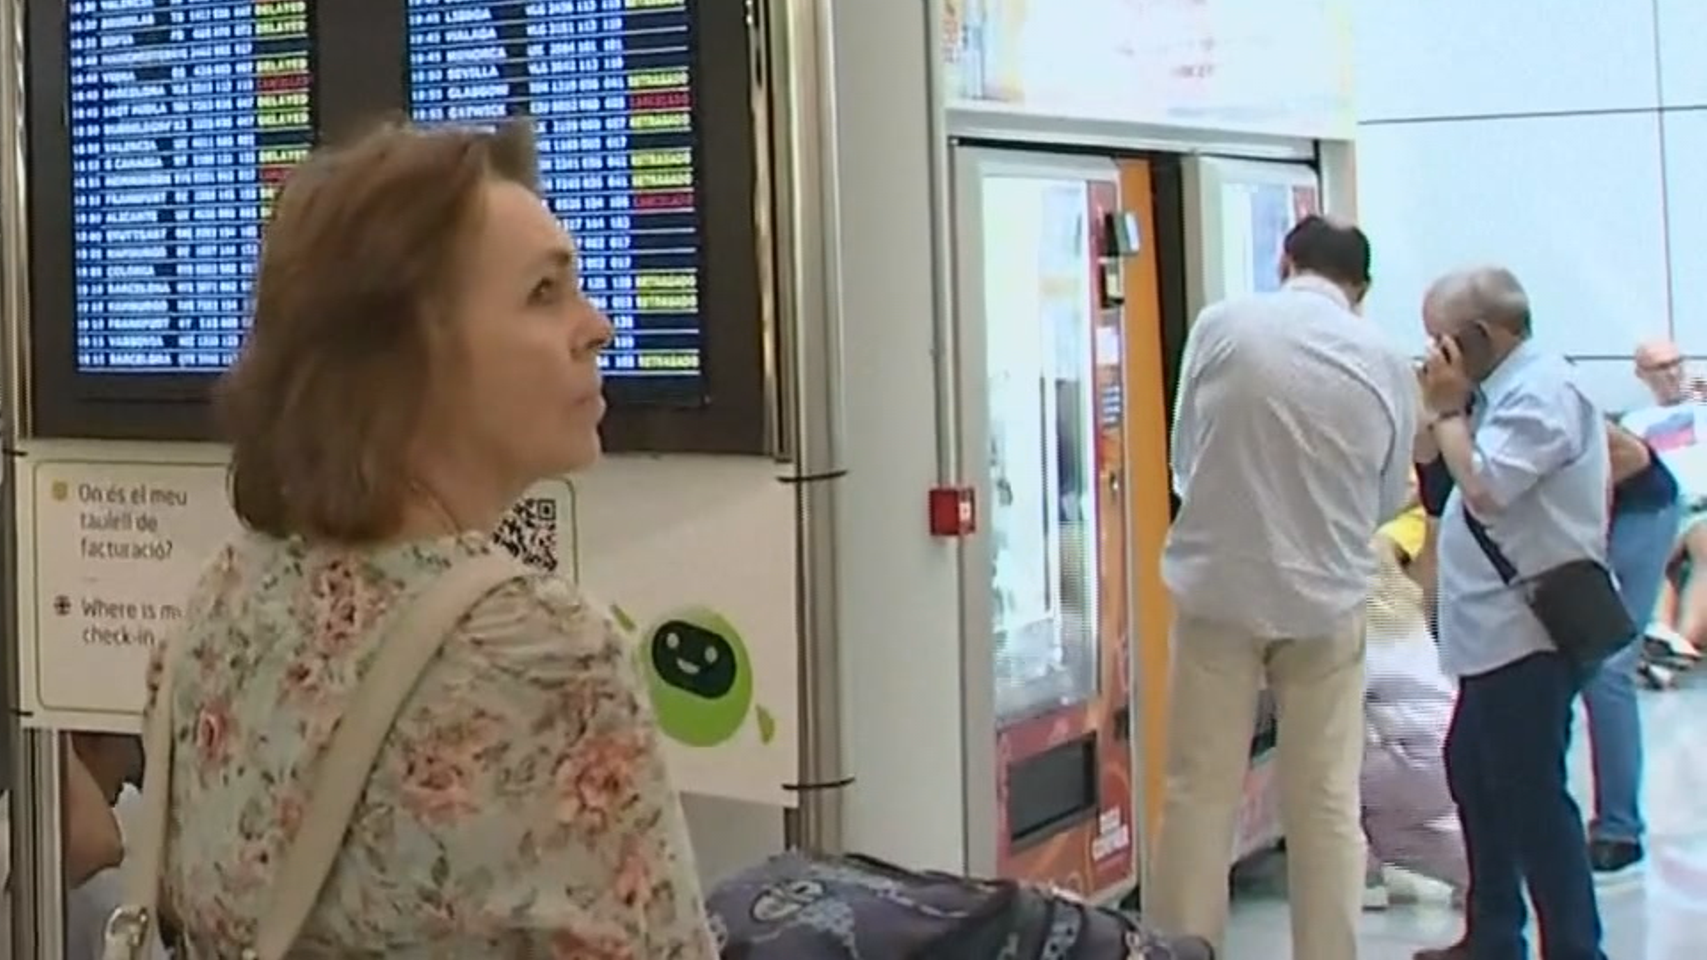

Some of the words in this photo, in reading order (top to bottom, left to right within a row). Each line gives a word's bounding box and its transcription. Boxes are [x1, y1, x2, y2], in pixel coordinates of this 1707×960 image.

[78, 483, 102, 503] On
[106, 483, 126, 504] és
[130, 484, 147, 504] el
[150, 487, 187, 506] meu
[80, 511, 133, 531] taulell
[136, 513, 158, 533] de
[80, 538, 174, 562] facturació?
[81, 597, 138, 620] Where
[143, 602, 157, 620] is
[82, 625, 155, 647] check-in
